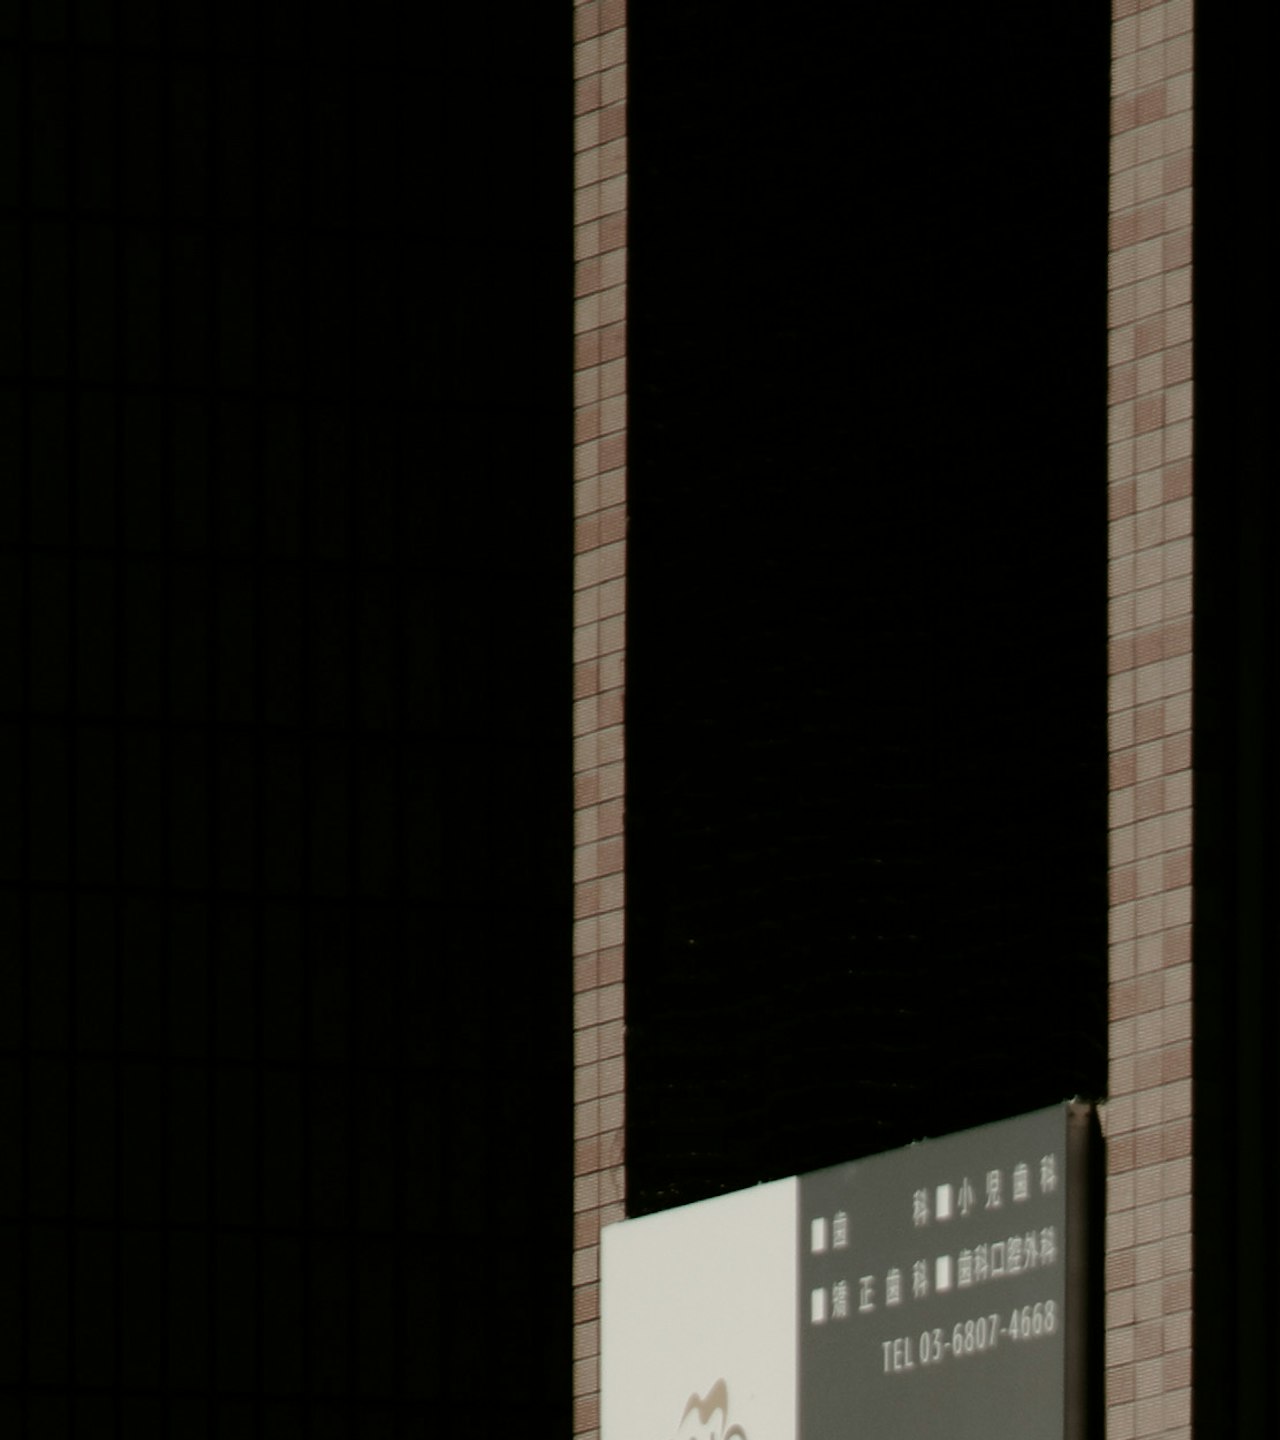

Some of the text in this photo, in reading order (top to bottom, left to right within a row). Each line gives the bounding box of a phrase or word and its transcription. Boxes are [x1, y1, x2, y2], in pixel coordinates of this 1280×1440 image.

[958, 1153, 1057, 1216] 小児歯科
[832, 1225, 1057, 1318] 矯正歯科 歯科口腔外科
[882, 1300, 1056, 1372] TEL 03-6807-4668
